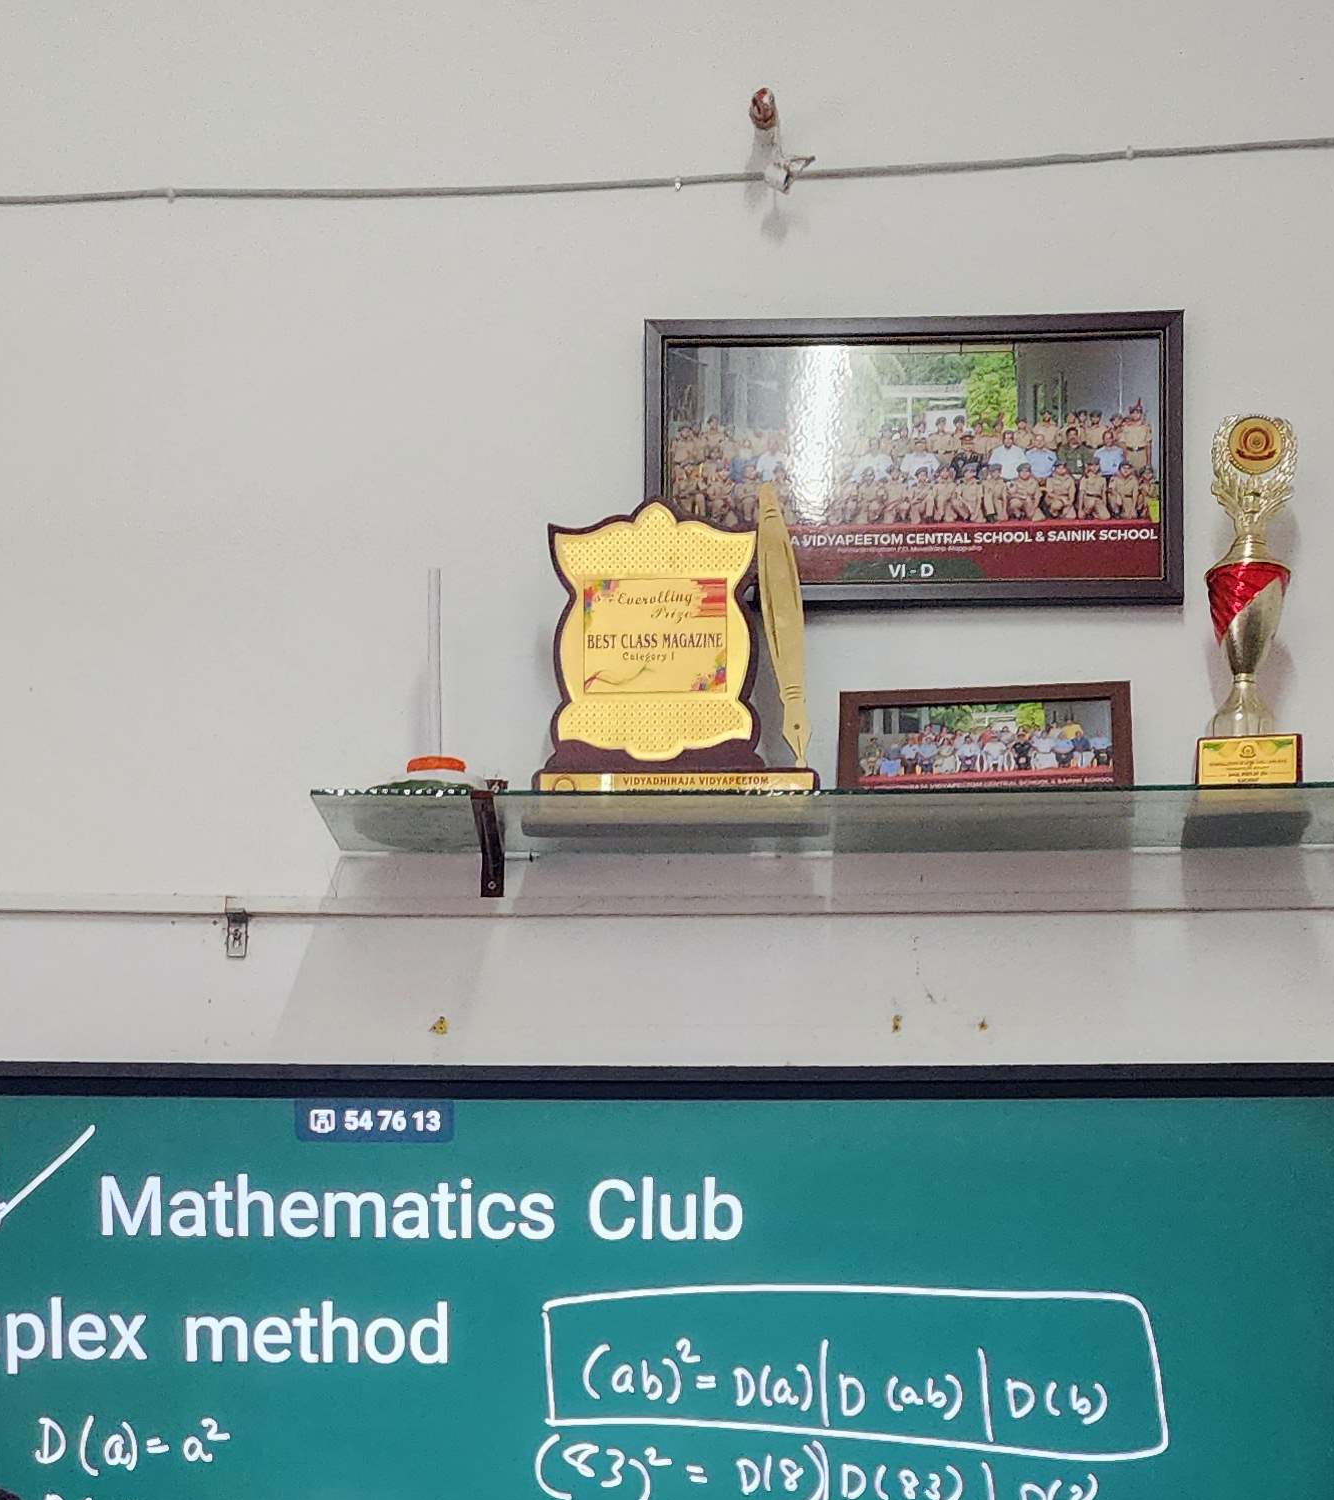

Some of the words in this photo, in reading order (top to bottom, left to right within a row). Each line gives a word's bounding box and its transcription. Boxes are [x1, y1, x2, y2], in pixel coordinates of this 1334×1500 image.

[802, 533, 903, 547] VIDYAPEETOM
[906, 532, 971, 545] CENTRAL
[974, 531, 1032, 544] SCHOOL
[1035, 531, 1046, 543] &
[1047, 529, 1096, 543] SAINIK
[1099, 528, 1158, 541] SCHOOL
[888, 563, 907, 578] VI
[920, 563, 935, 578] D
[587, 633, 617, 649] BEST
[621, 633, 658, 649] CLASS
[662, 632, 723, 649] MAGAZINE
[623, 776, 696, 786] VIDYADHIRAJA
[699, 776, 770, 786] VIDYAPEETOM
[344, 1109, 373, 1131] 54
[377, 1109, 407, 1132] 76
[412, 1109, 441, 1132] 13
[99, 1173, 556, 1241] Mathematics
[588, 1176, 745, 1243] Club
[184, 1299, 450, 1366] method
